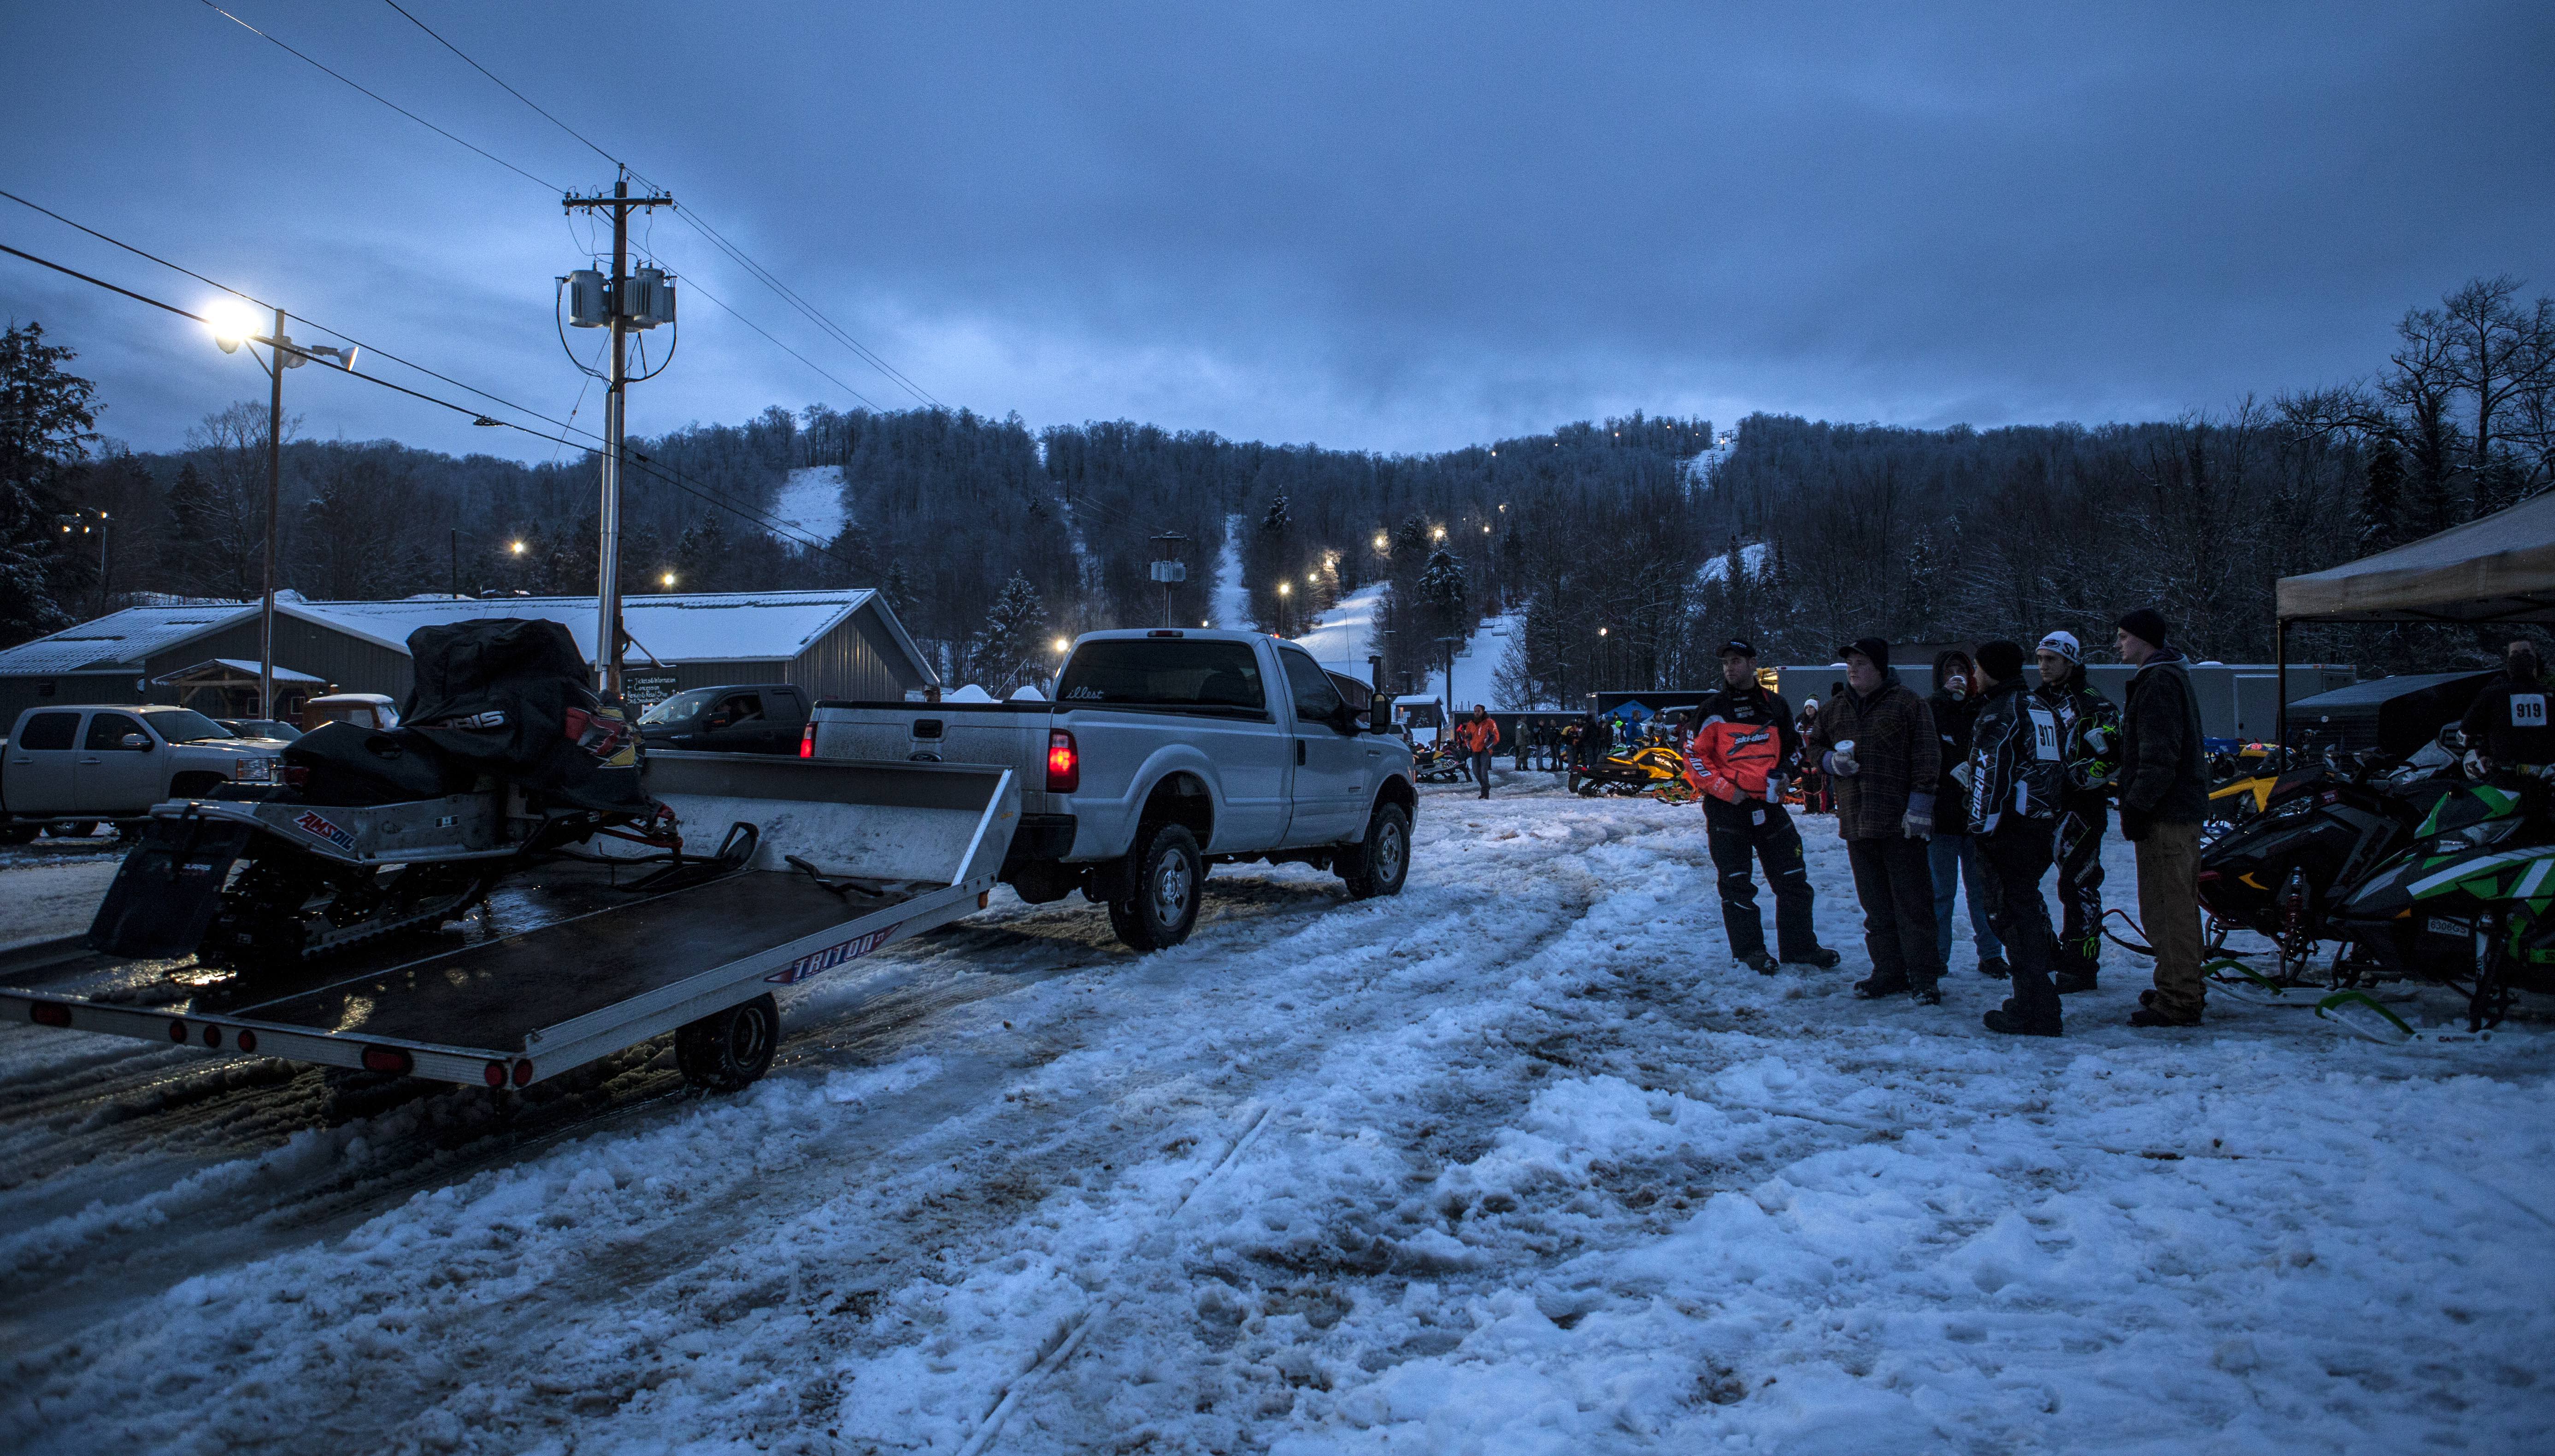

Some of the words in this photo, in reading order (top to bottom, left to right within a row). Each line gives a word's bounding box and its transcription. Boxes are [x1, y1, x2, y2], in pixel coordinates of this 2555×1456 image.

[1066, 687, 1104, 699] illest
[2516, 703, 2541, 718] 919
[2038, 724, 2054, 746] 917
[297, 810, 355, 851] AMSOIL
[794, 933, 874, 981] TRITON
